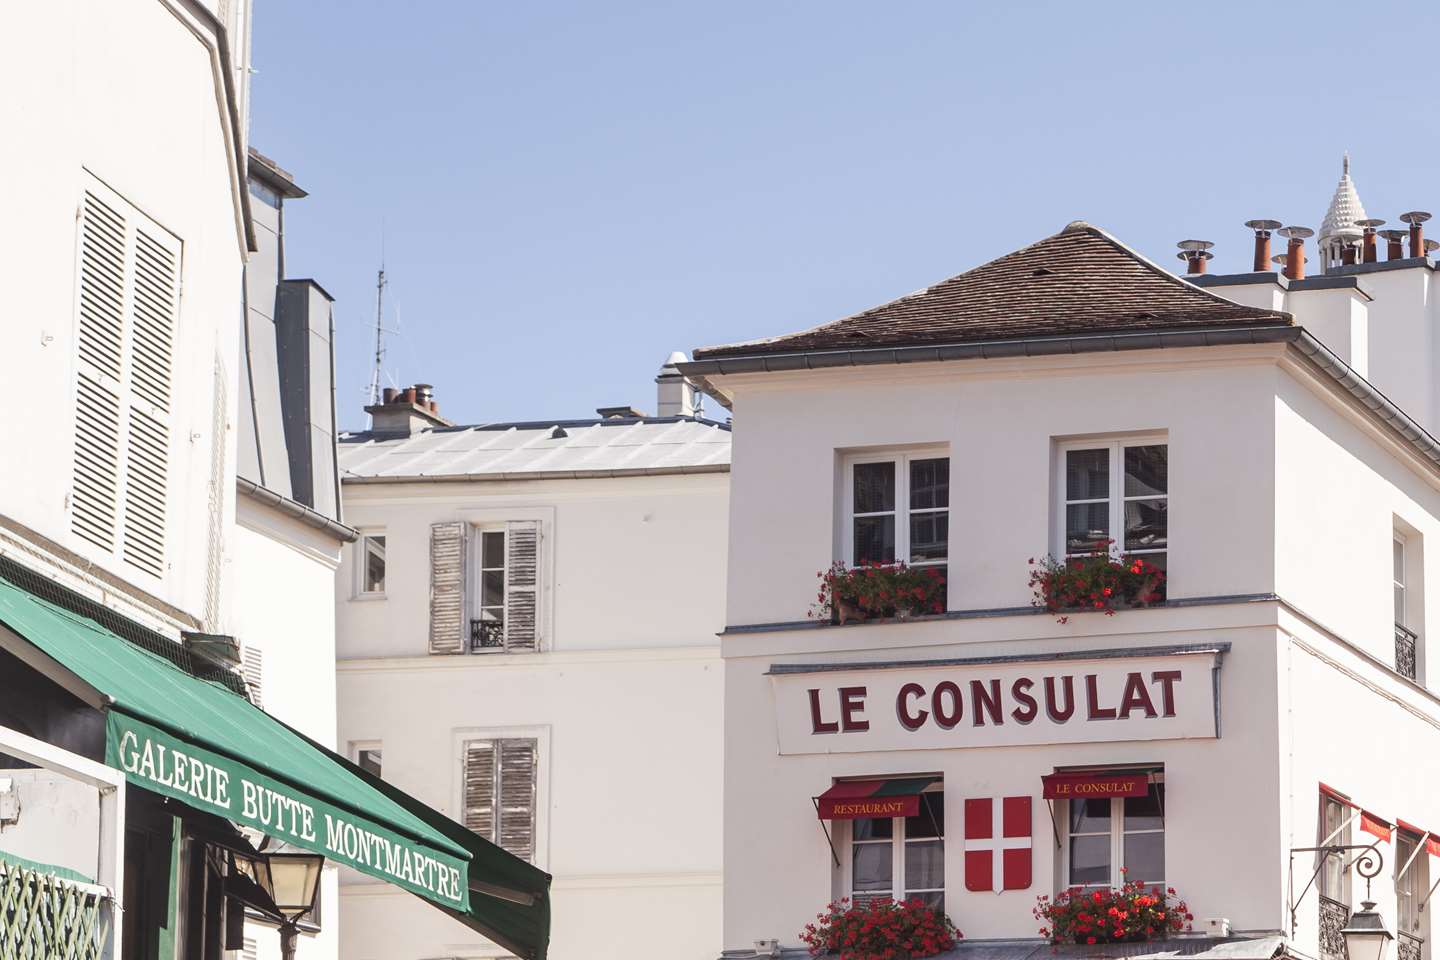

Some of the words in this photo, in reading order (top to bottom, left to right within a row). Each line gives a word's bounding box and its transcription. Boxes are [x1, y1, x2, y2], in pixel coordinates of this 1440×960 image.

[808, 686, 870, 735] LE
[896, 670, 1182, 732] CONSULAT
[1056, 783, 1070, 794] LE
[1074, 782, 1135, 793] CONSULAT
[119, 730, 231, 809] GALERIE
[241, 779, 316, 842] BUTTE
[324, 814, 463, 901] MONTMARTRE
[833, 802, 904, 815] RESTAURANT
